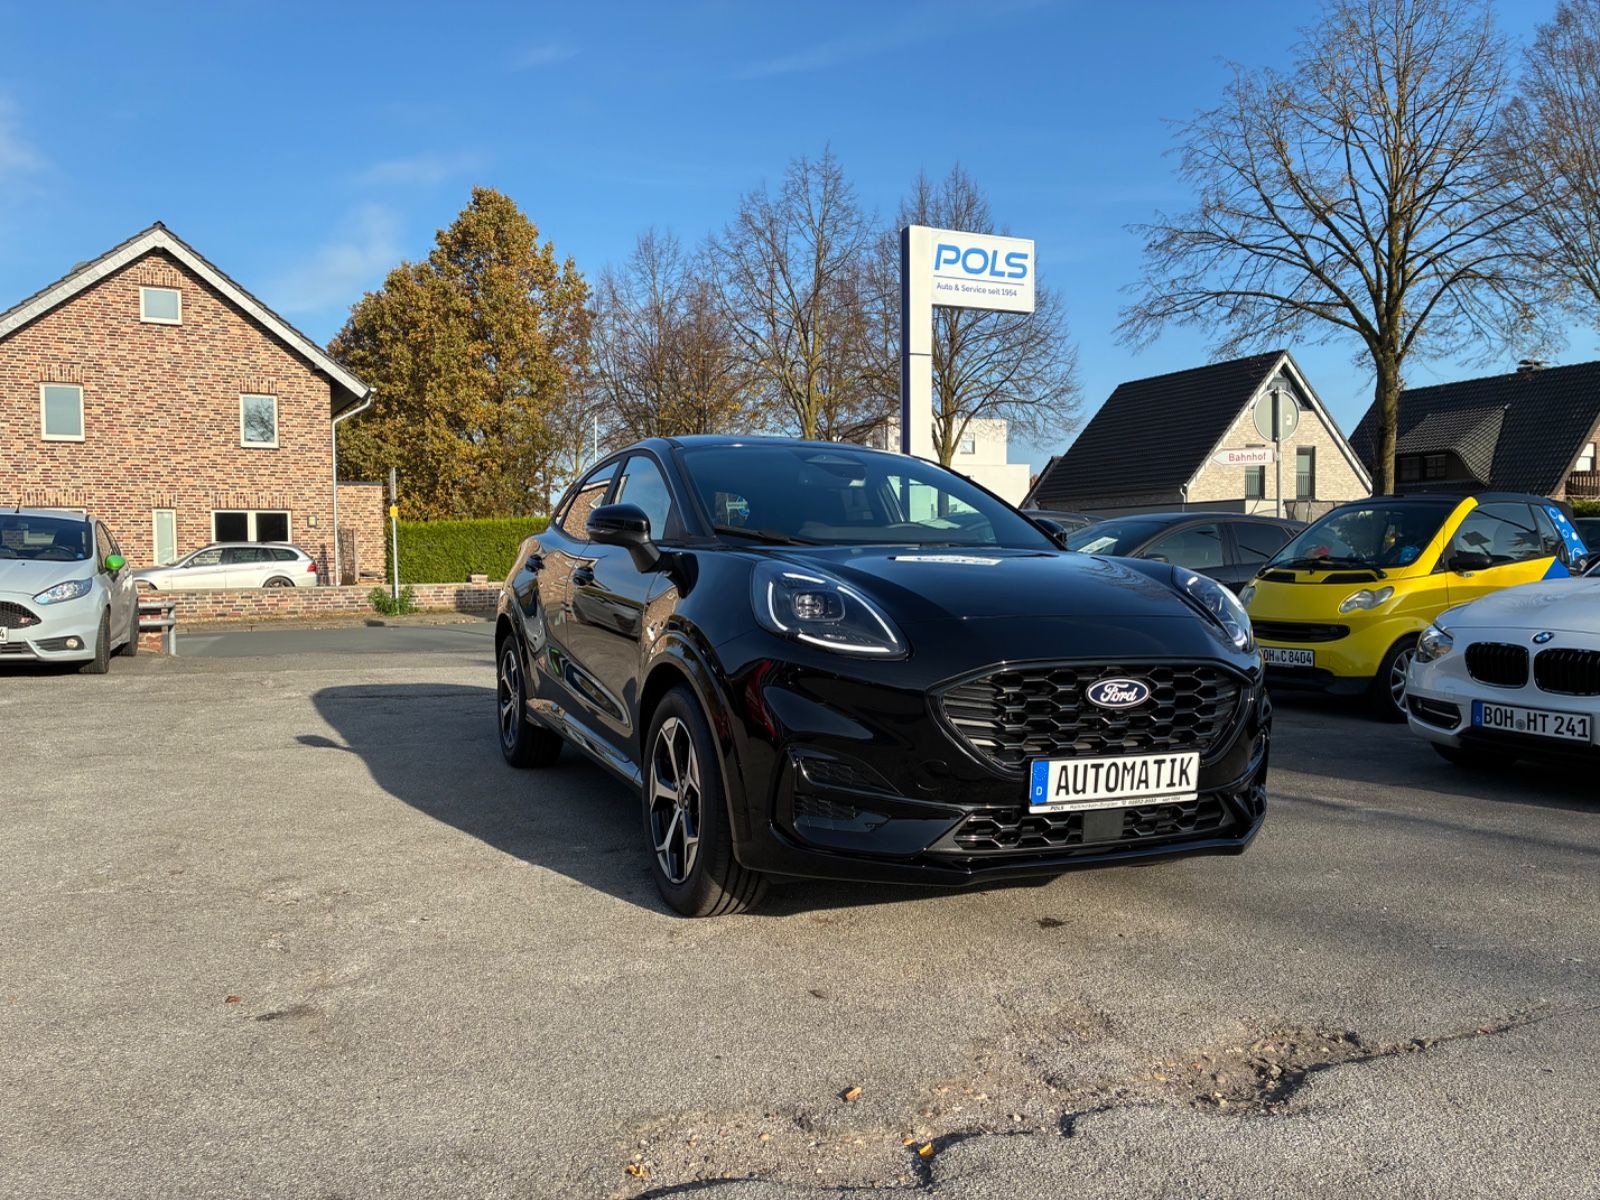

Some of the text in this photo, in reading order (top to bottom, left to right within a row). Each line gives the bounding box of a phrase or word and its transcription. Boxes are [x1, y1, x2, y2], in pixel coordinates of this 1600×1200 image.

[934, 243, 1029, 279] POLS
[936, 282, 1018, 297] Auto & Service seit 1954
[1228, 452, 1266, 462] Bahnhof
[1263, 649, 1312, 665] OH C 8404
[1099, 682, 1138, 702] Ford
[1484, 705, 1588, 738] BOH HT 241
[1055, 757, 1193, 796] AUTOMATIK
[1036, 786, 1043, 796] D
